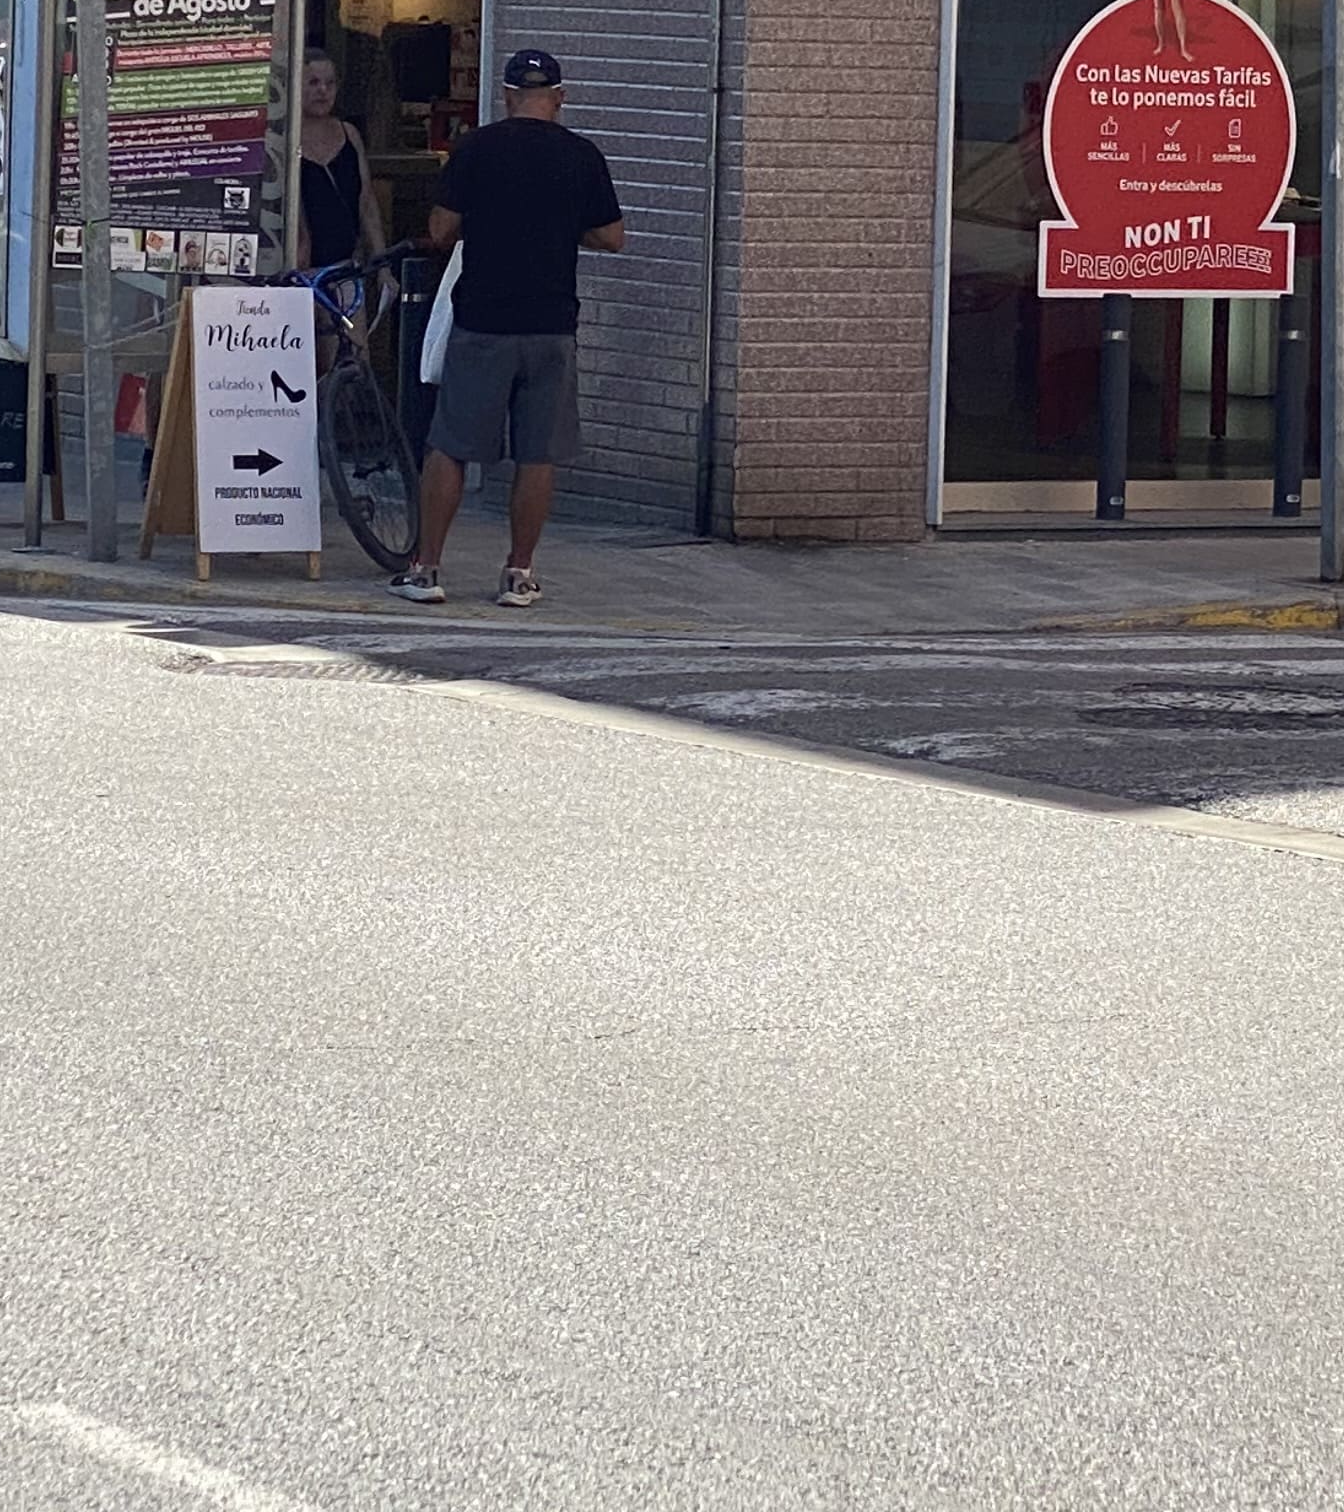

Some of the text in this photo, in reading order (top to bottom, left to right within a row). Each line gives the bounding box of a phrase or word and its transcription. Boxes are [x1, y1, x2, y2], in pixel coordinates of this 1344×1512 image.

[1075, 64, 1272, 87] Con las Nuevas Tarifas
[1090, 88, 1256, 110] te lo ponemos fácil
[1100, 142, 1118, 151] MÁS
[1163, 142, 1181, 151] MÁS
[1227, 144, 1241, 153] SIN
[1087, 151, 1130, 162] SENCILLAS
[1156, 153, 1187, 162] CLARAS
[1212, 153, 1256, 163] SORPRESAS
[1119, 179, 1223, 193] Entra y descúbrelas
[1124, 215, 1211, 249] NON TI
[236, 299, 271, 316] Tienda
[206, 324, 304, 352] Mihaela
[208, 376, 264, 392] calzado y
[209, 404, 300, 419] complementos
[215, 487, 302, 499] PRODUCTO NACIONAL
[235, 512, 284, 526] ECONÓMICO
